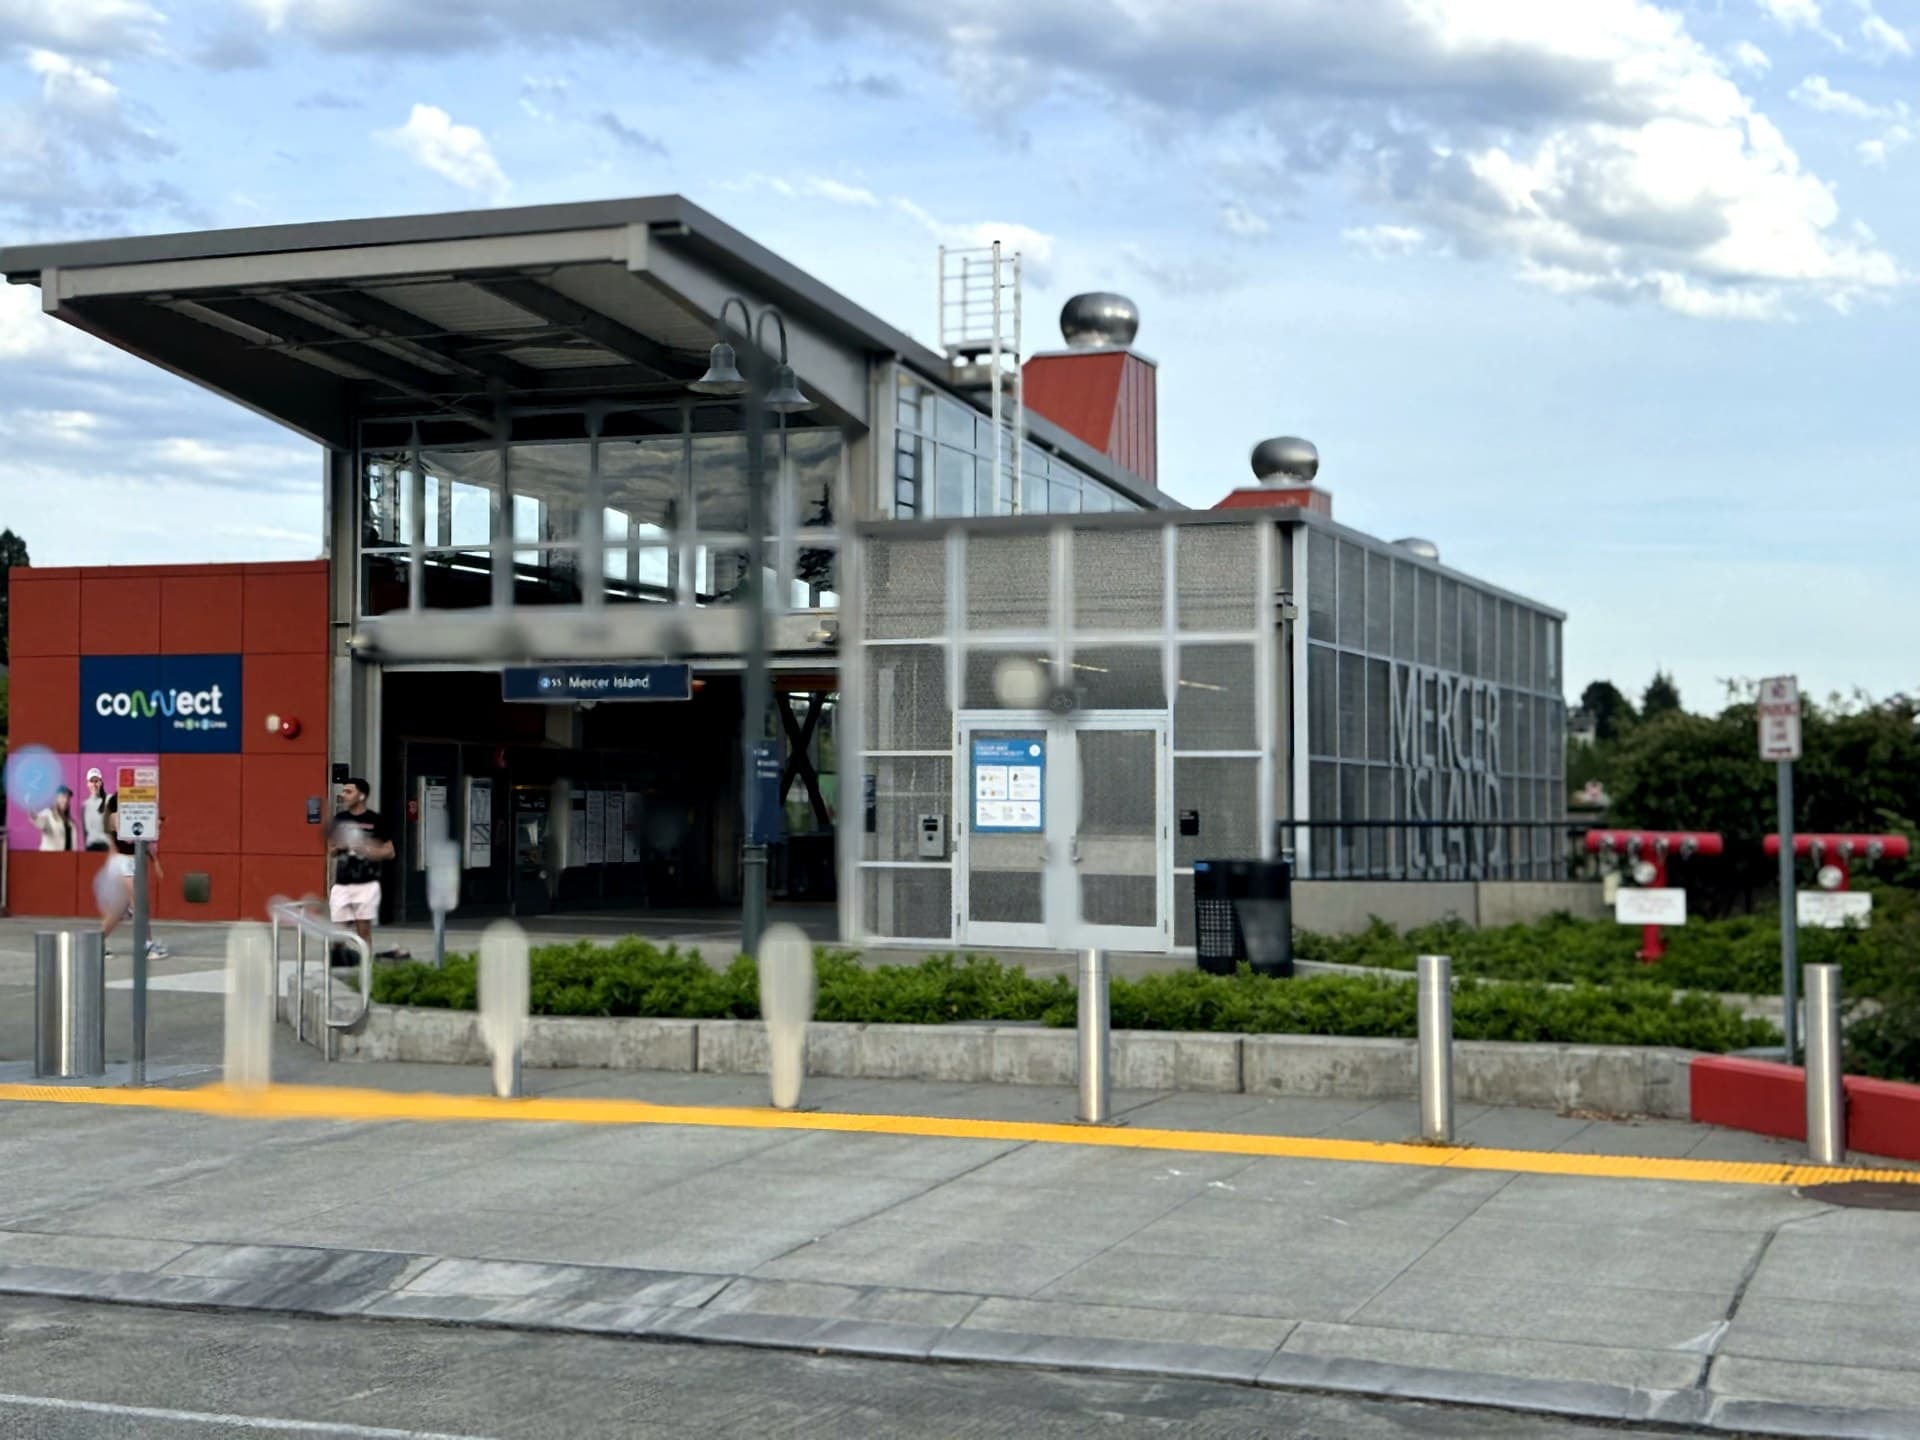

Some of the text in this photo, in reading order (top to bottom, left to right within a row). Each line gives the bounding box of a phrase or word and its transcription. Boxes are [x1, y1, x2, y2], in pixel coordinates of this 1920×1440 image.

[568, 675, 609, 689] Mercer
[613, 673, 649, 689] Island
[1390, 660, 1500, 775] MERCER
[1404, 766, 1501, 872] ISLAND
